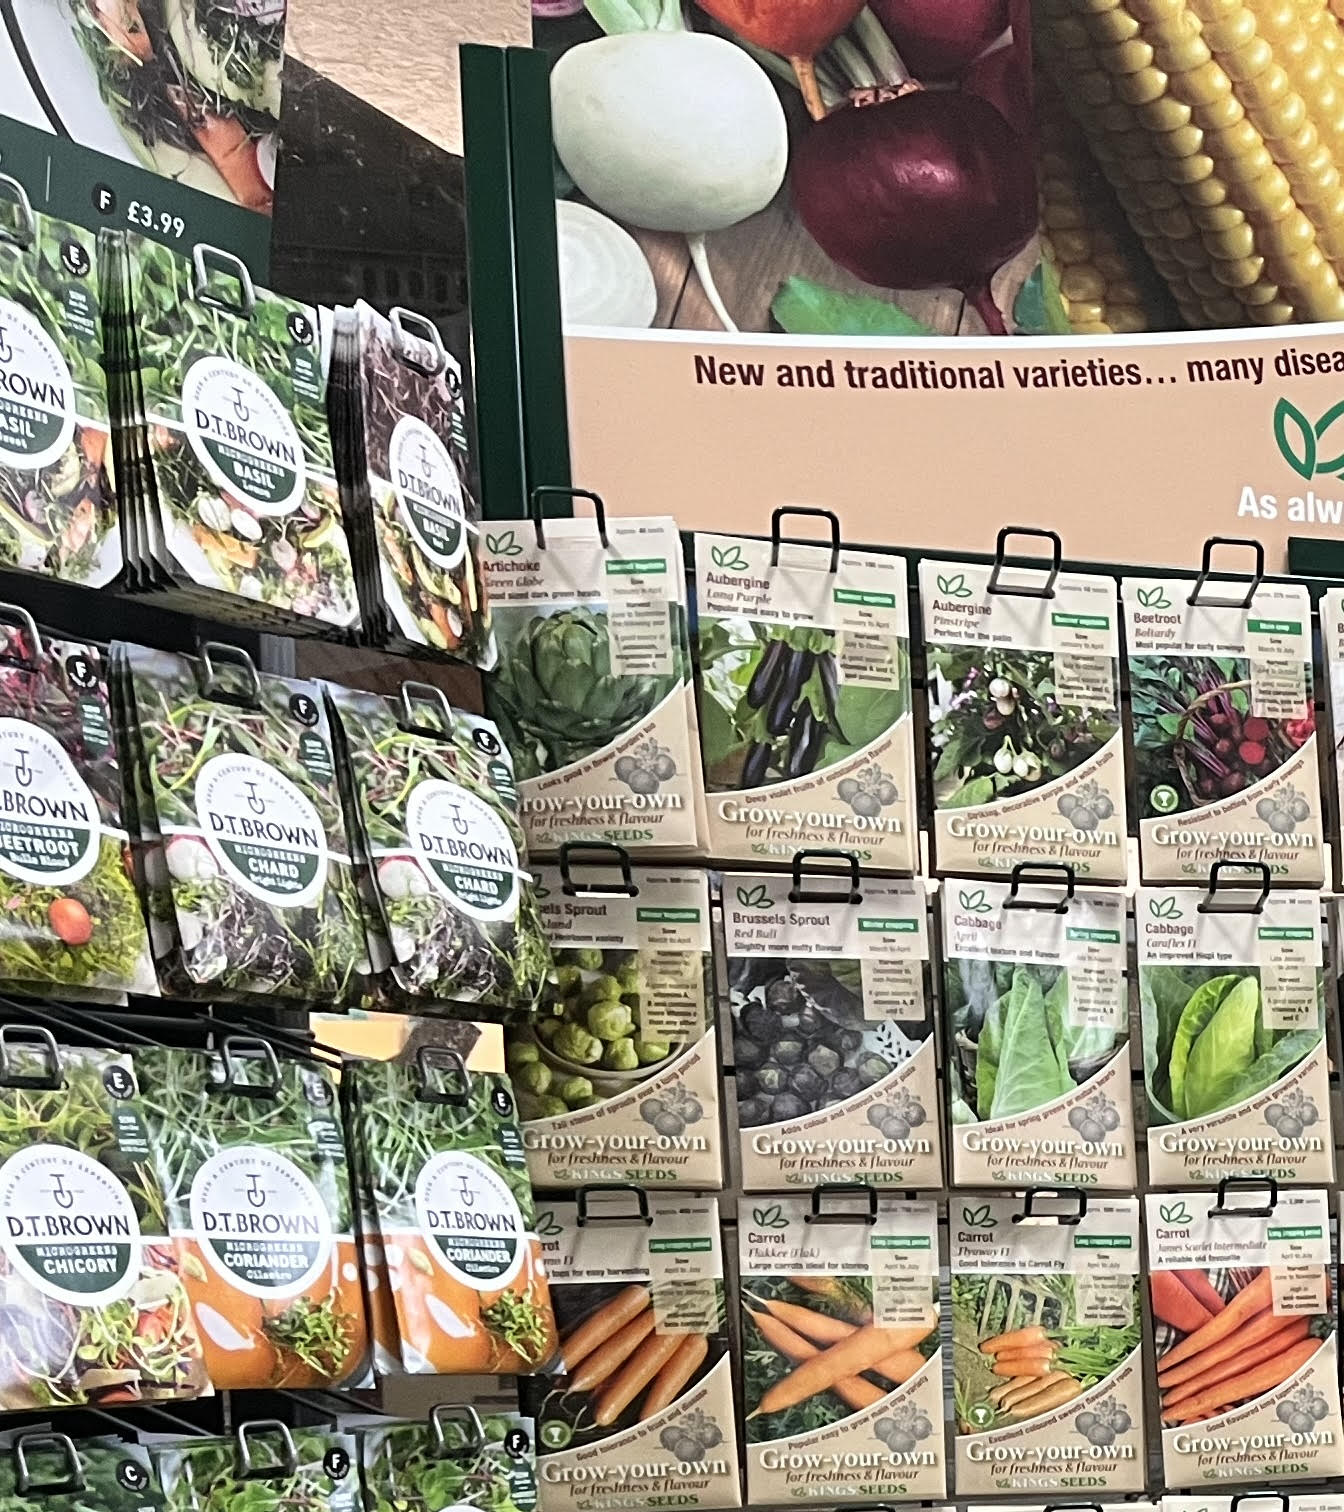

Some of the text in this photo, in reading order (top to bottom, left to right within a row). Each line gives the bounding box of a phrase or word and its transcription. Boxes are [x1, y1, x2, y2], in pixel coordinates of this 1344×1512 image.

[99, 189, 186, 238] F £3.99
[694, 353, 764, 387] New
[777, 357, 835, 388] and
[845, 360, 1004, 390] traditional
[1188, 353, 1264, 387] many
[233, 458, 276, 490] BASIL
[1237, 487, 1279, 519] As
[706, 572, 770, 589] Aubergine
[1134, 613, 1181, 624] Beetroot
[719, 803, 901, 834] Grow-your-own
[248, 856, 300, 880] CHARD
[733, 912, 830, 928] Brussels Sprout
[1156, 1228, 1190, 1239] Carrot
[44, 1255, 117, 1274] CHICORY
[223, 1252, 309, 1270] CORIANDER
[760, 1449, 936, 1472] Grow-your-own
